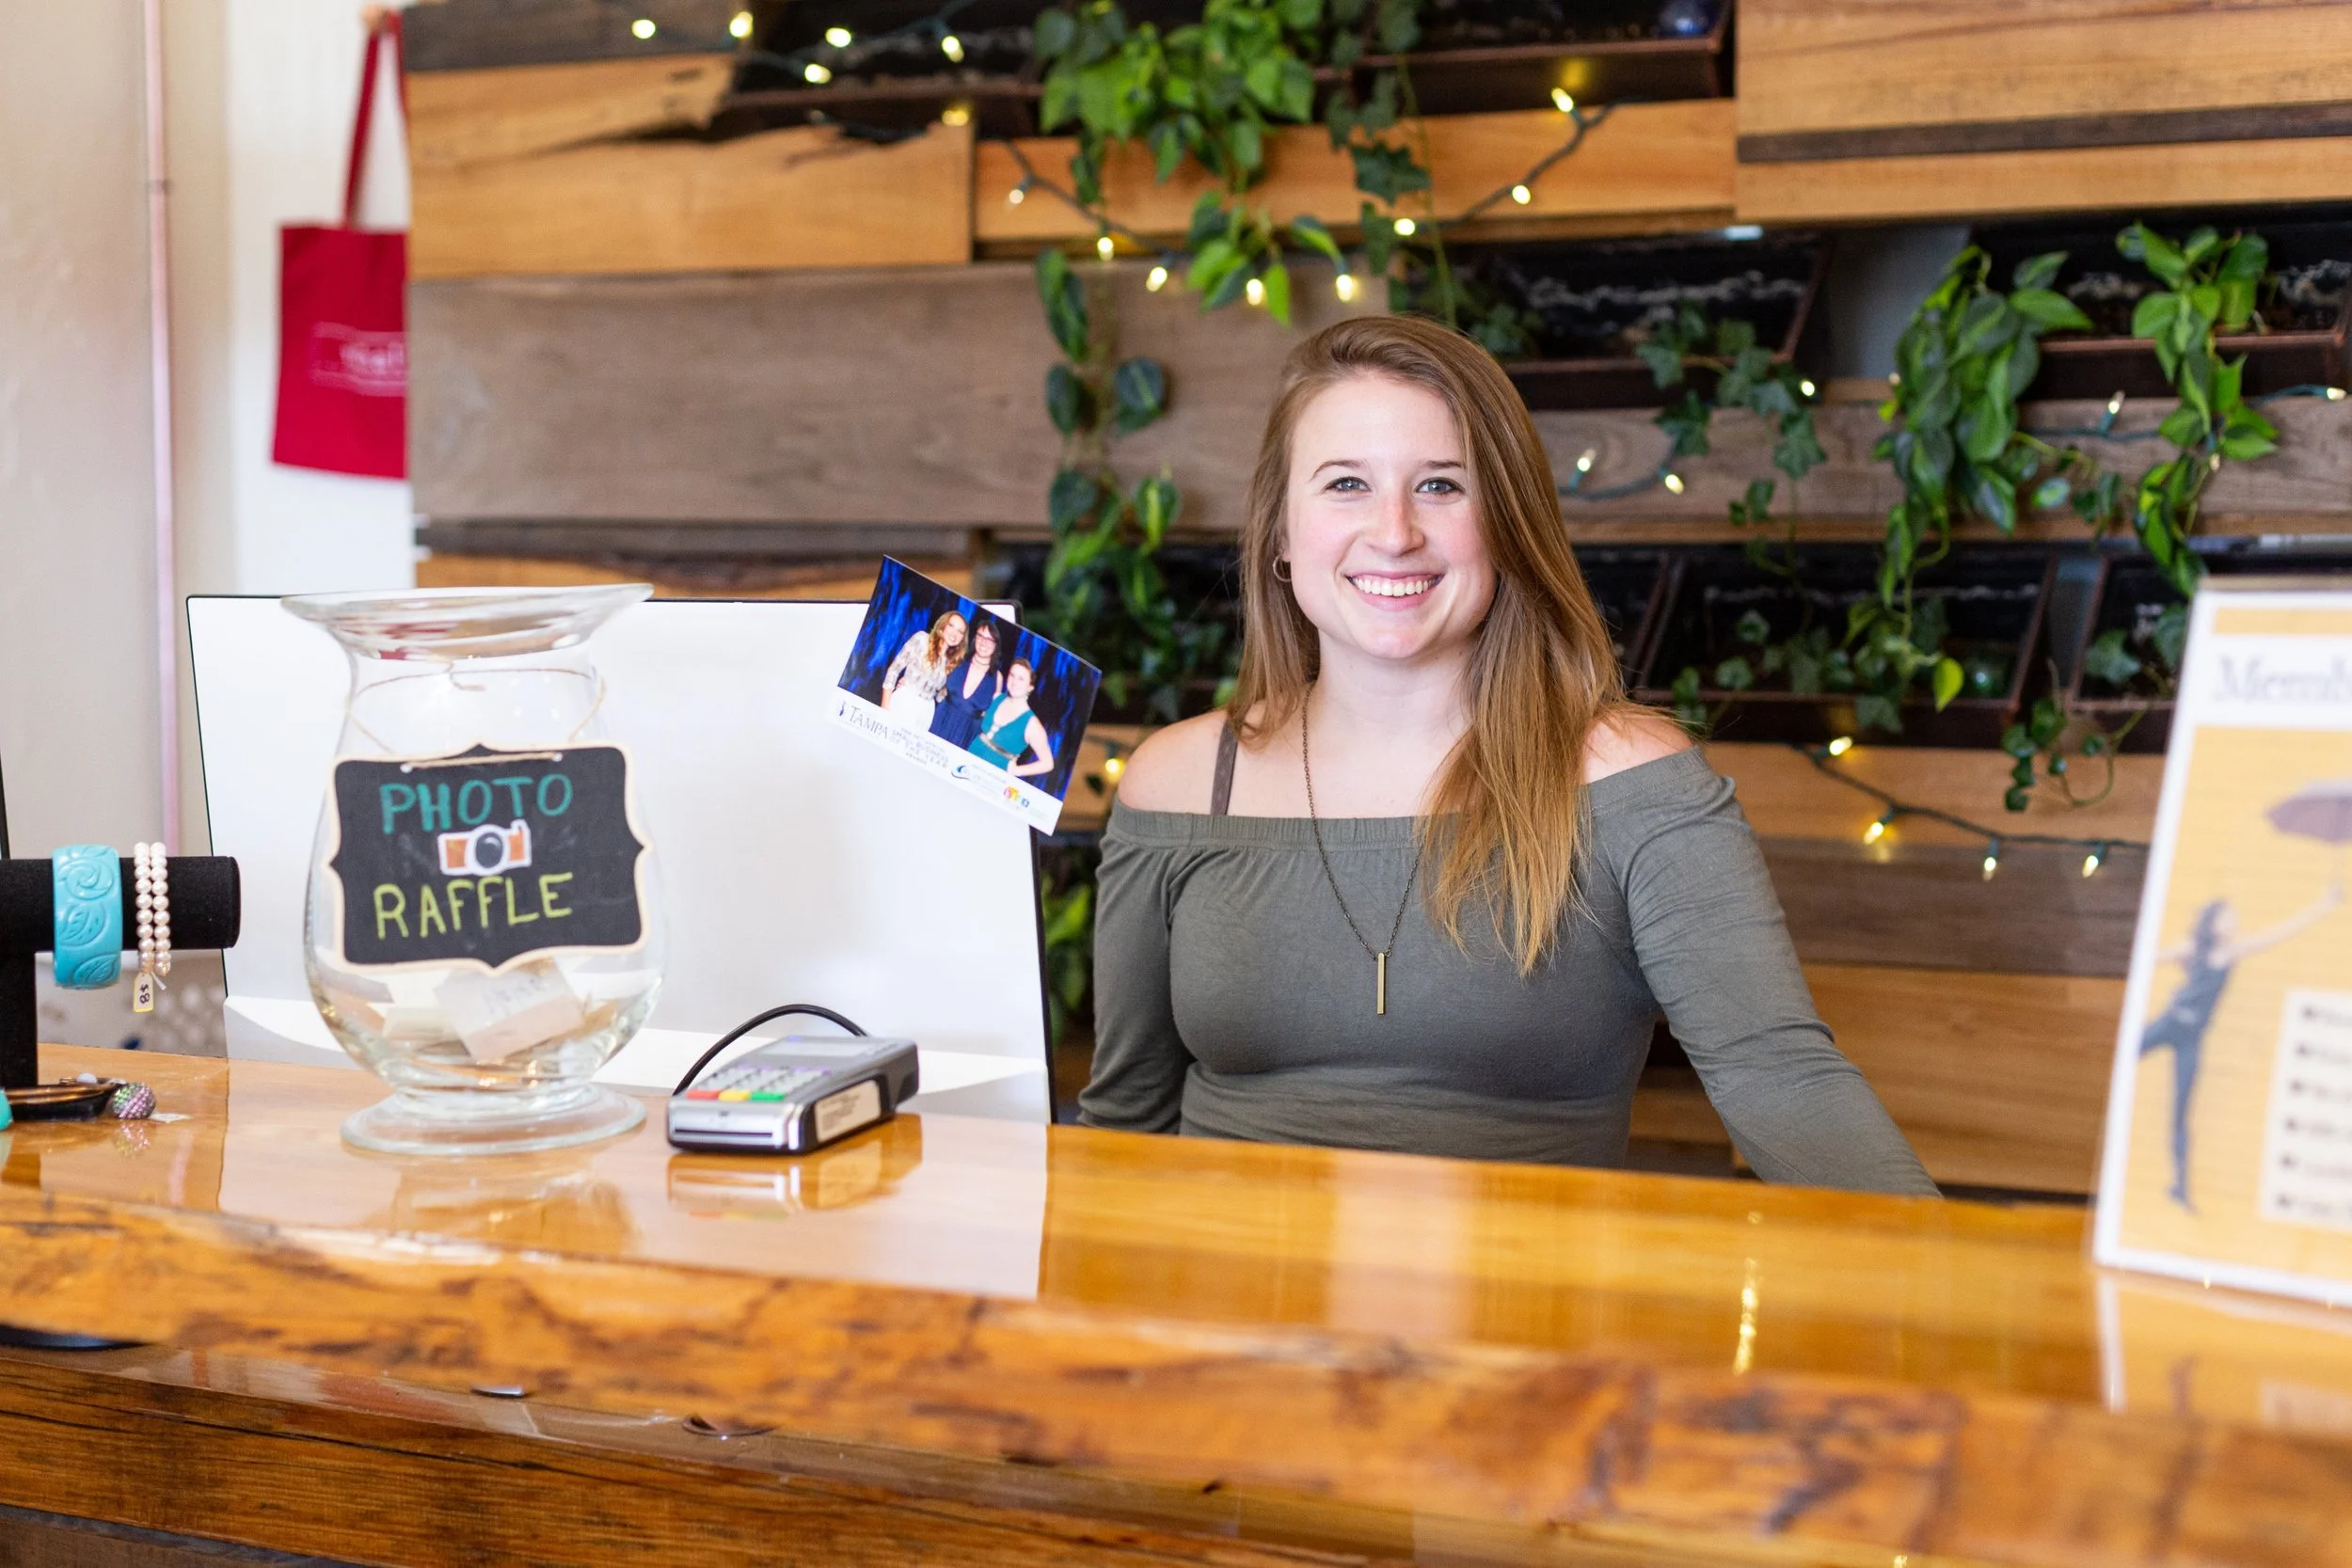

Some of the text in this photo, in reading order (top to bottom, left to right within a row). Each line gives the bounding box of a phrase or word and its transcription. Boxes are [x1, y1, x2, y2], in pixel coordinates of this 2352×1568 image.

[850, 705, 888, 738] TAMPA
[378, 773, 573, 834] PHOTO
[373, 872, 574, 940] RAFFLE
